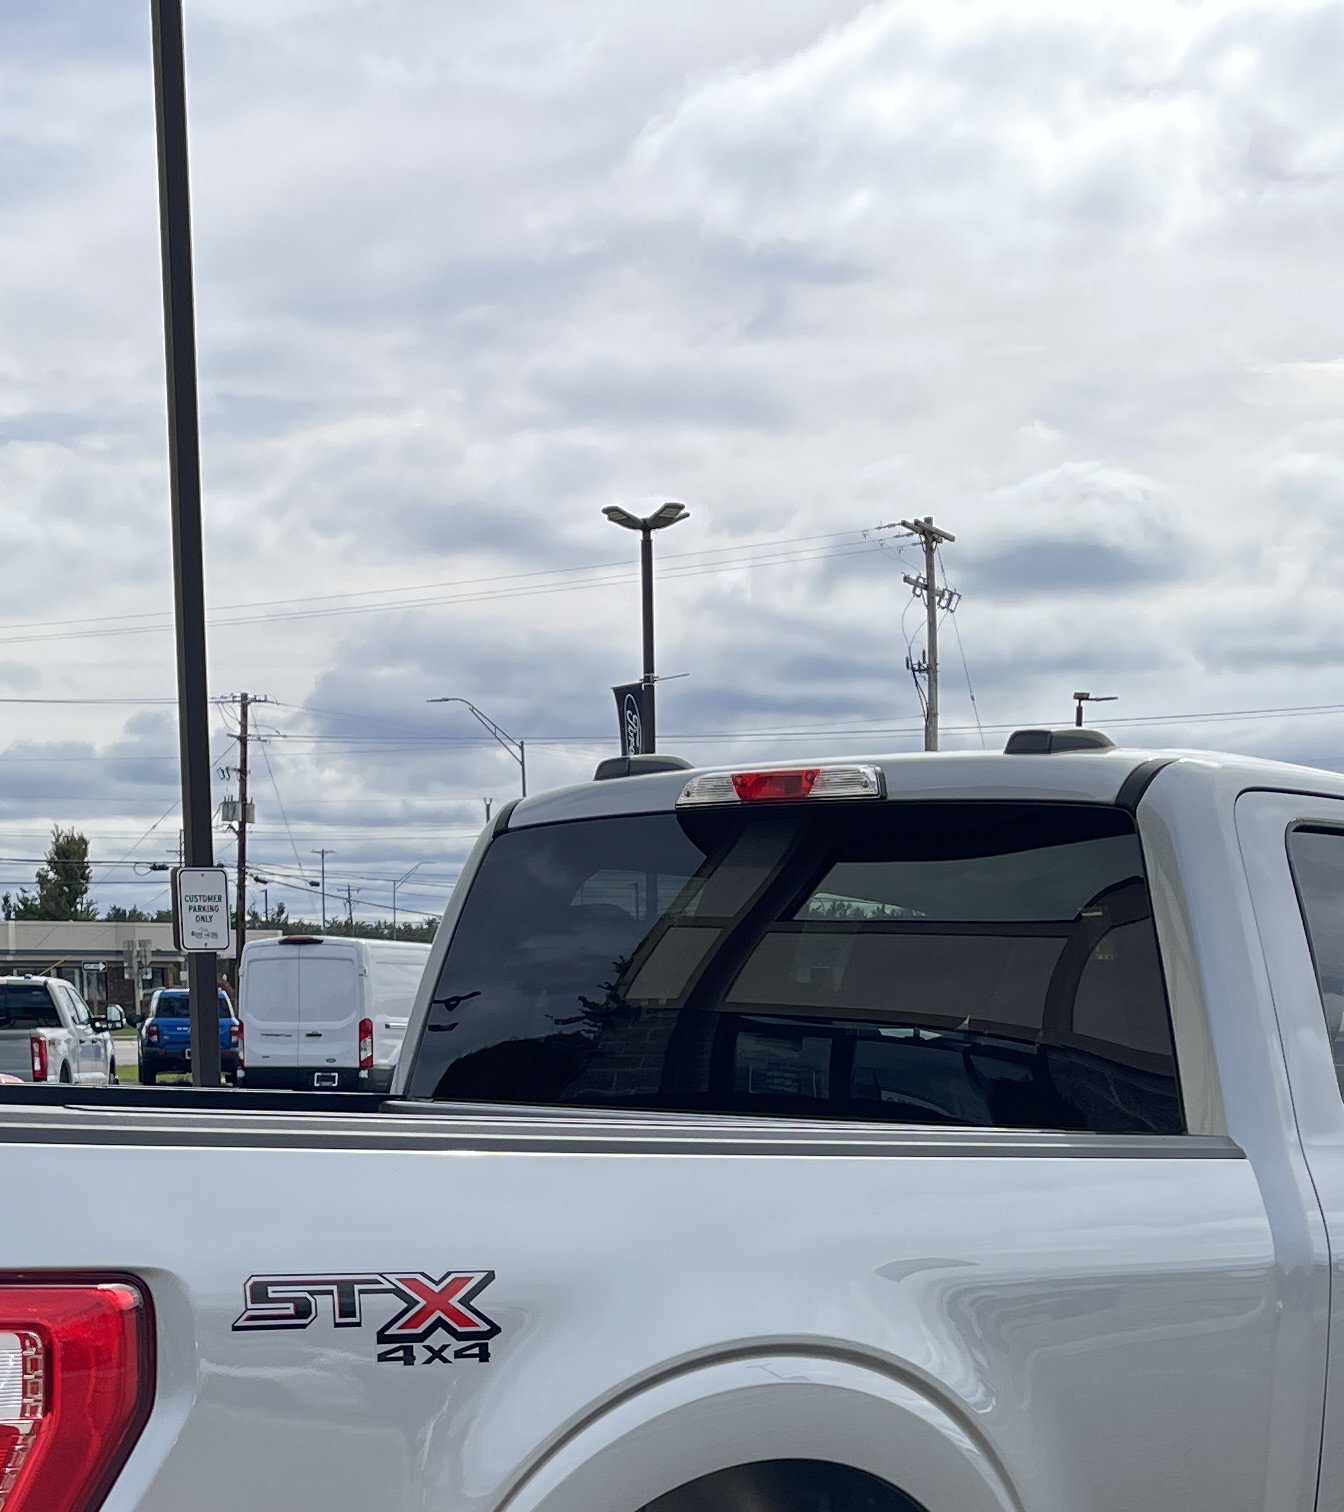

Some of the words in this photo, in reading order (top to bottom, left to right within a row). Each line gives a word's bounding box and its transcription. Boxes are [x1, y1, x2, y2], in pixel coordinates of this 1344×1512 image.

[184, 894, 223, 903] CUSTOMER
[188, 904, 220, 913] PARKING
[195, 914, 214, 923] ONLY
[232, 1269, 502, 1345] STX
